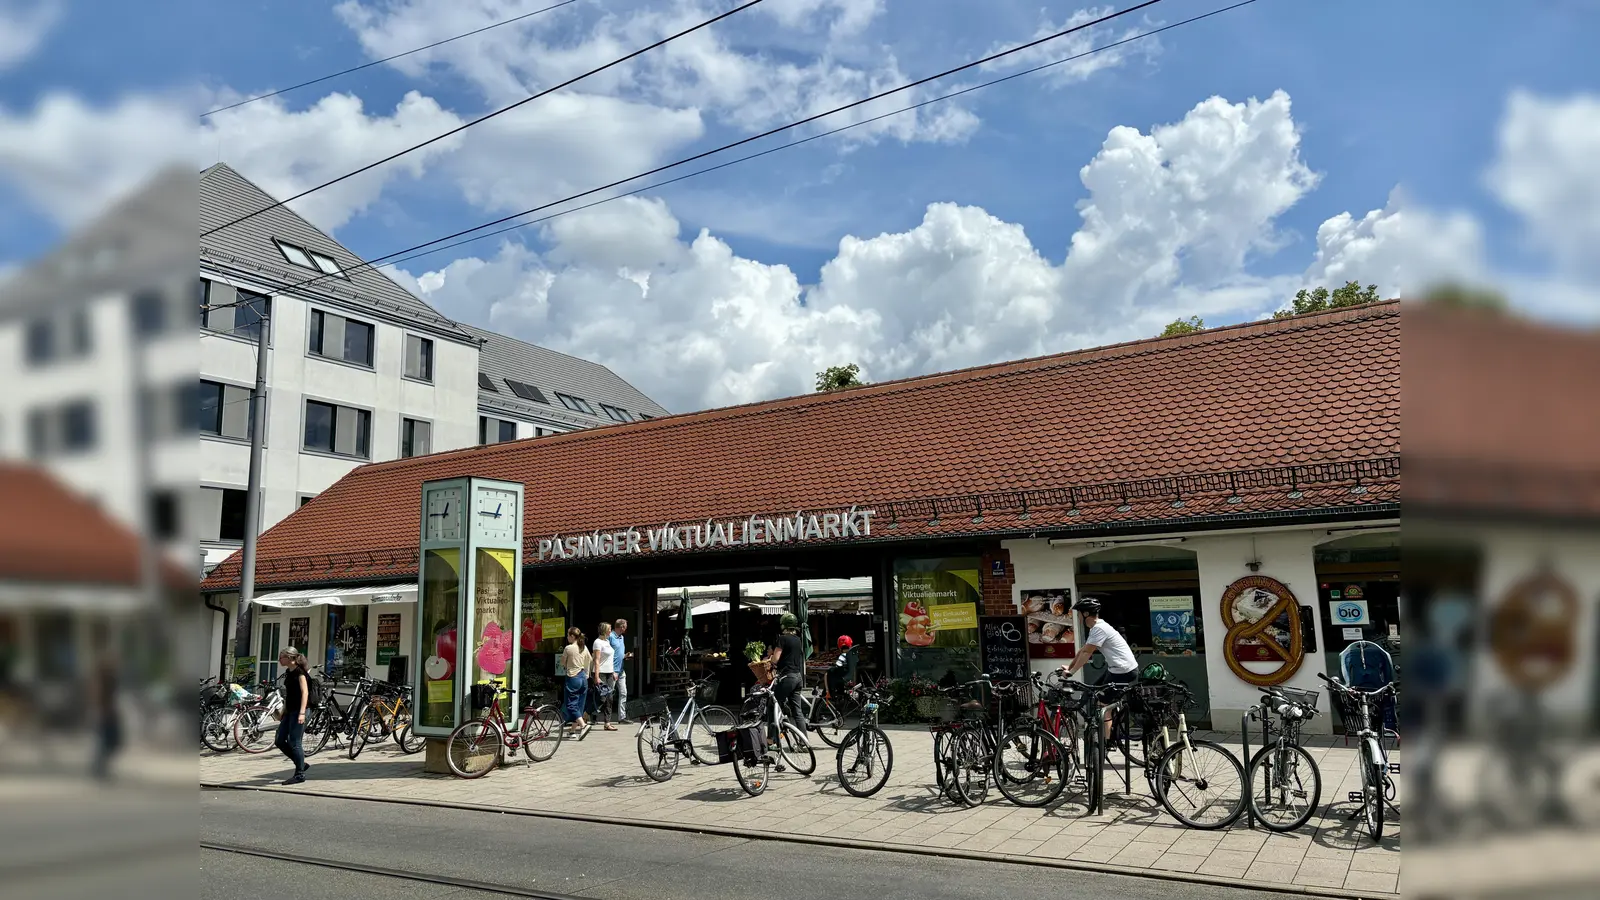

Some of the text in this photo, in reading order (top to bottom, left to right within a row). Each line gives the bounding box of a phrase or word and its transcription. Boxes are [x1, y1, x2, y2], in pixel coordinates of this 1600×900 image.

[538, 507, 876, 561] PASINGER VIKTUALIENMARKT
[995, 561, 1001, 569] 7
[902, 583, 931, 591] Pasinger
[902, 590, 957, 598] Viktualienmarkt
[1338, 608, 1360, 618] bio
[340, 630, 354, 652] He
